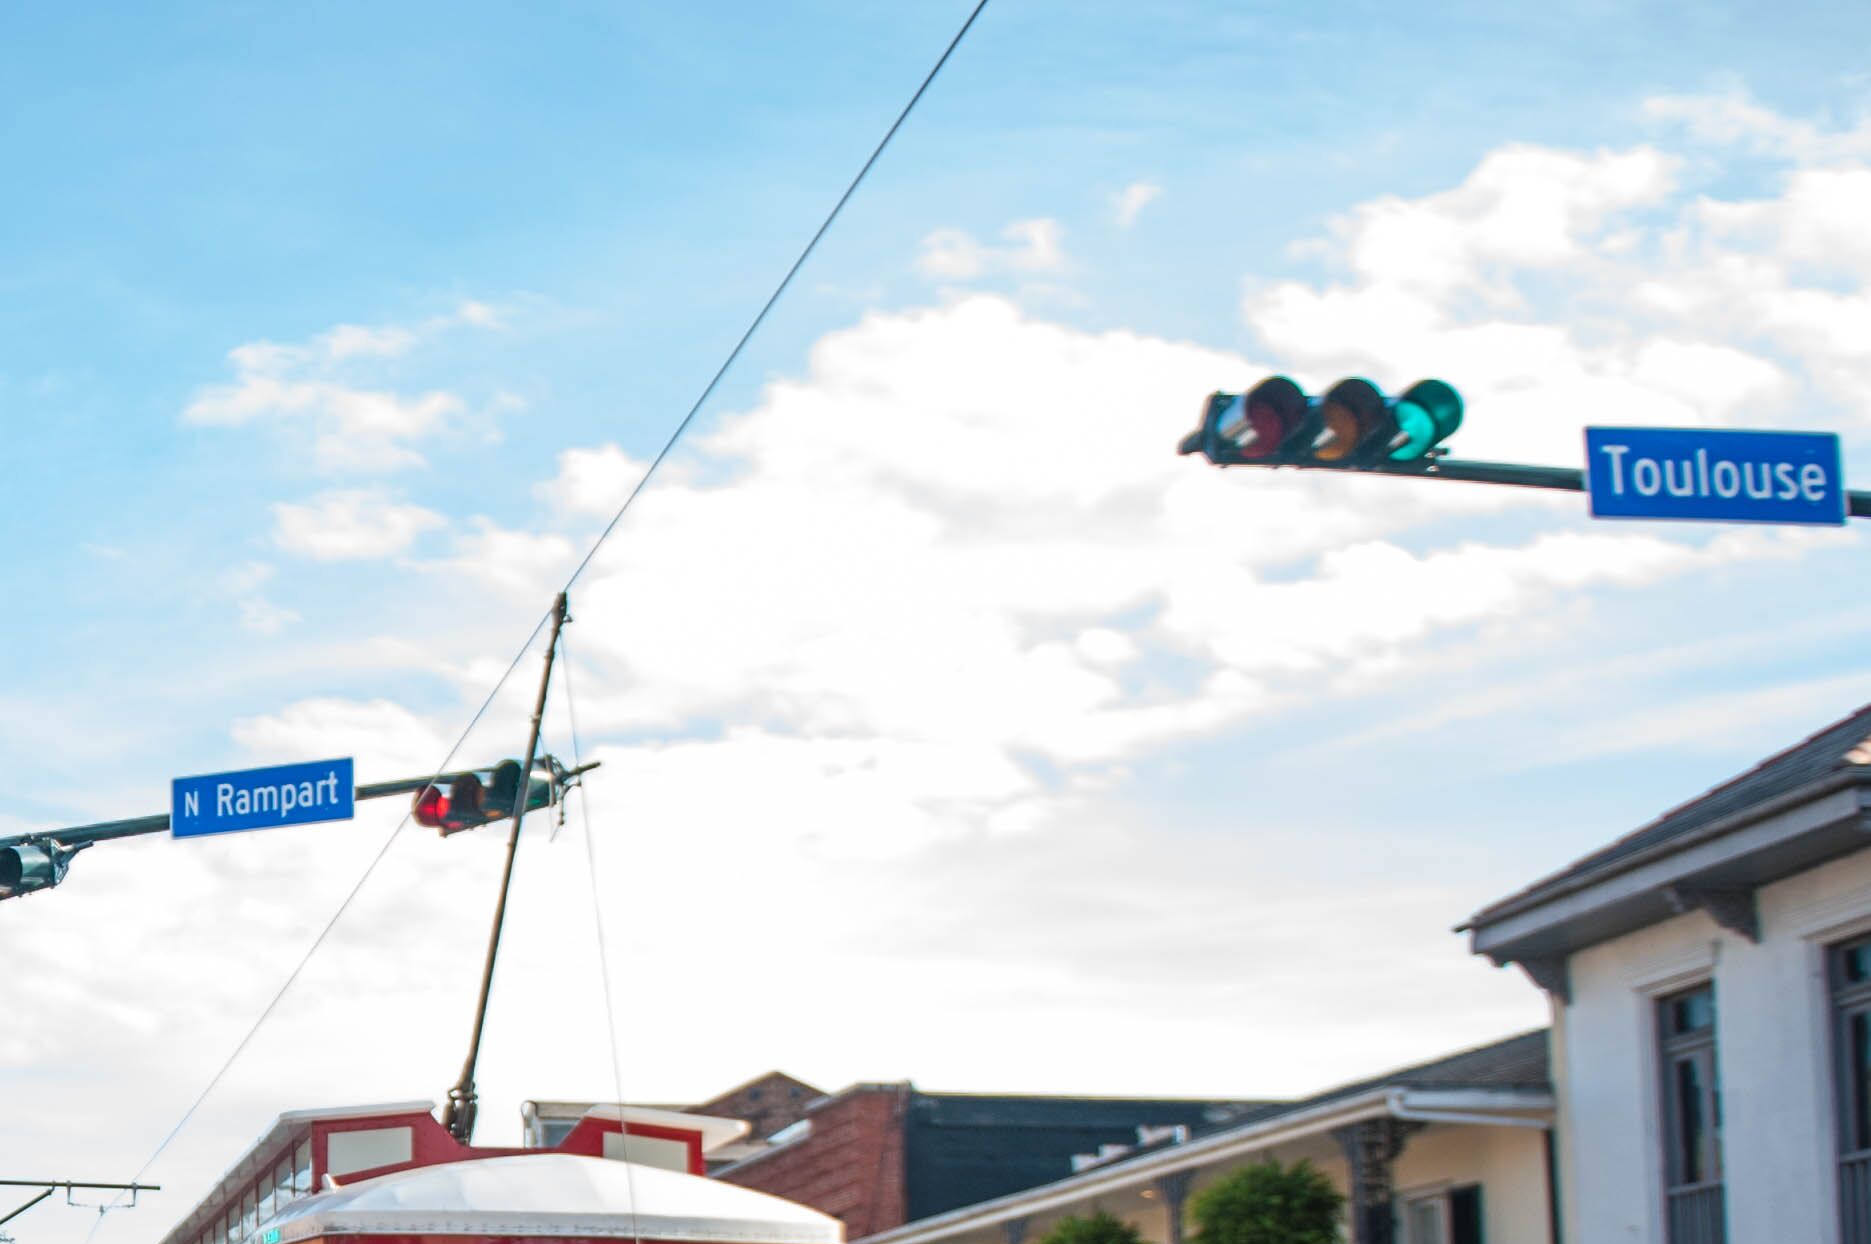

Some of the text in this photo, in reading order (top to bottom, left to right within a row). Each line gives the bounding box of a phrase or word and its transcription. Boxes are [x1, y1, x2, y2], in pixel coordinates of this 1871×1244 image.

[1601, 445, 1826, 500] Toulouse
[185, 771, 338, 817] N Rampart
